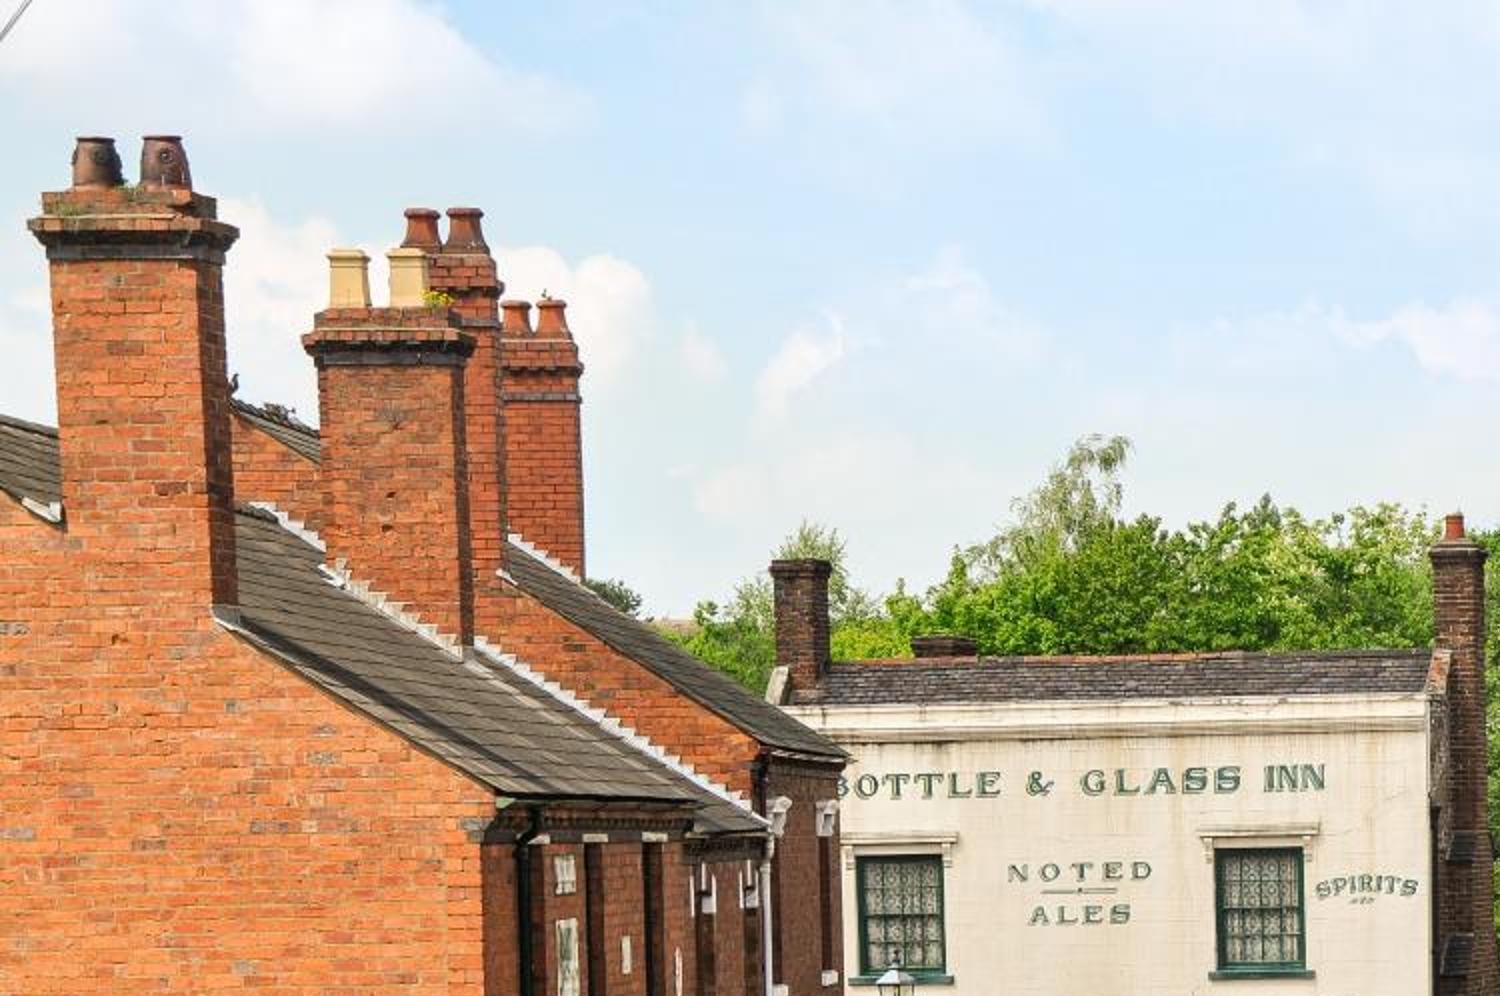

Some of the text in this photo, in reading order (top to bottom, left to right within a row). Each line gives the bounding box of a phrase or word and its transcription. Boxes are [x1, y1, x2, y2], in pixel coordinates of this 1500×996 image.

[1026, 771, 1055, 796] &
[1080, 766, 1241, 796] GLASS
[1263, 764, 1326, 792] INN
[1008, 861, 1152, 882] NOTED
[1315, 874, 1419, 899] SPIRITS
[1028, 904, 1131, 925] ALES
